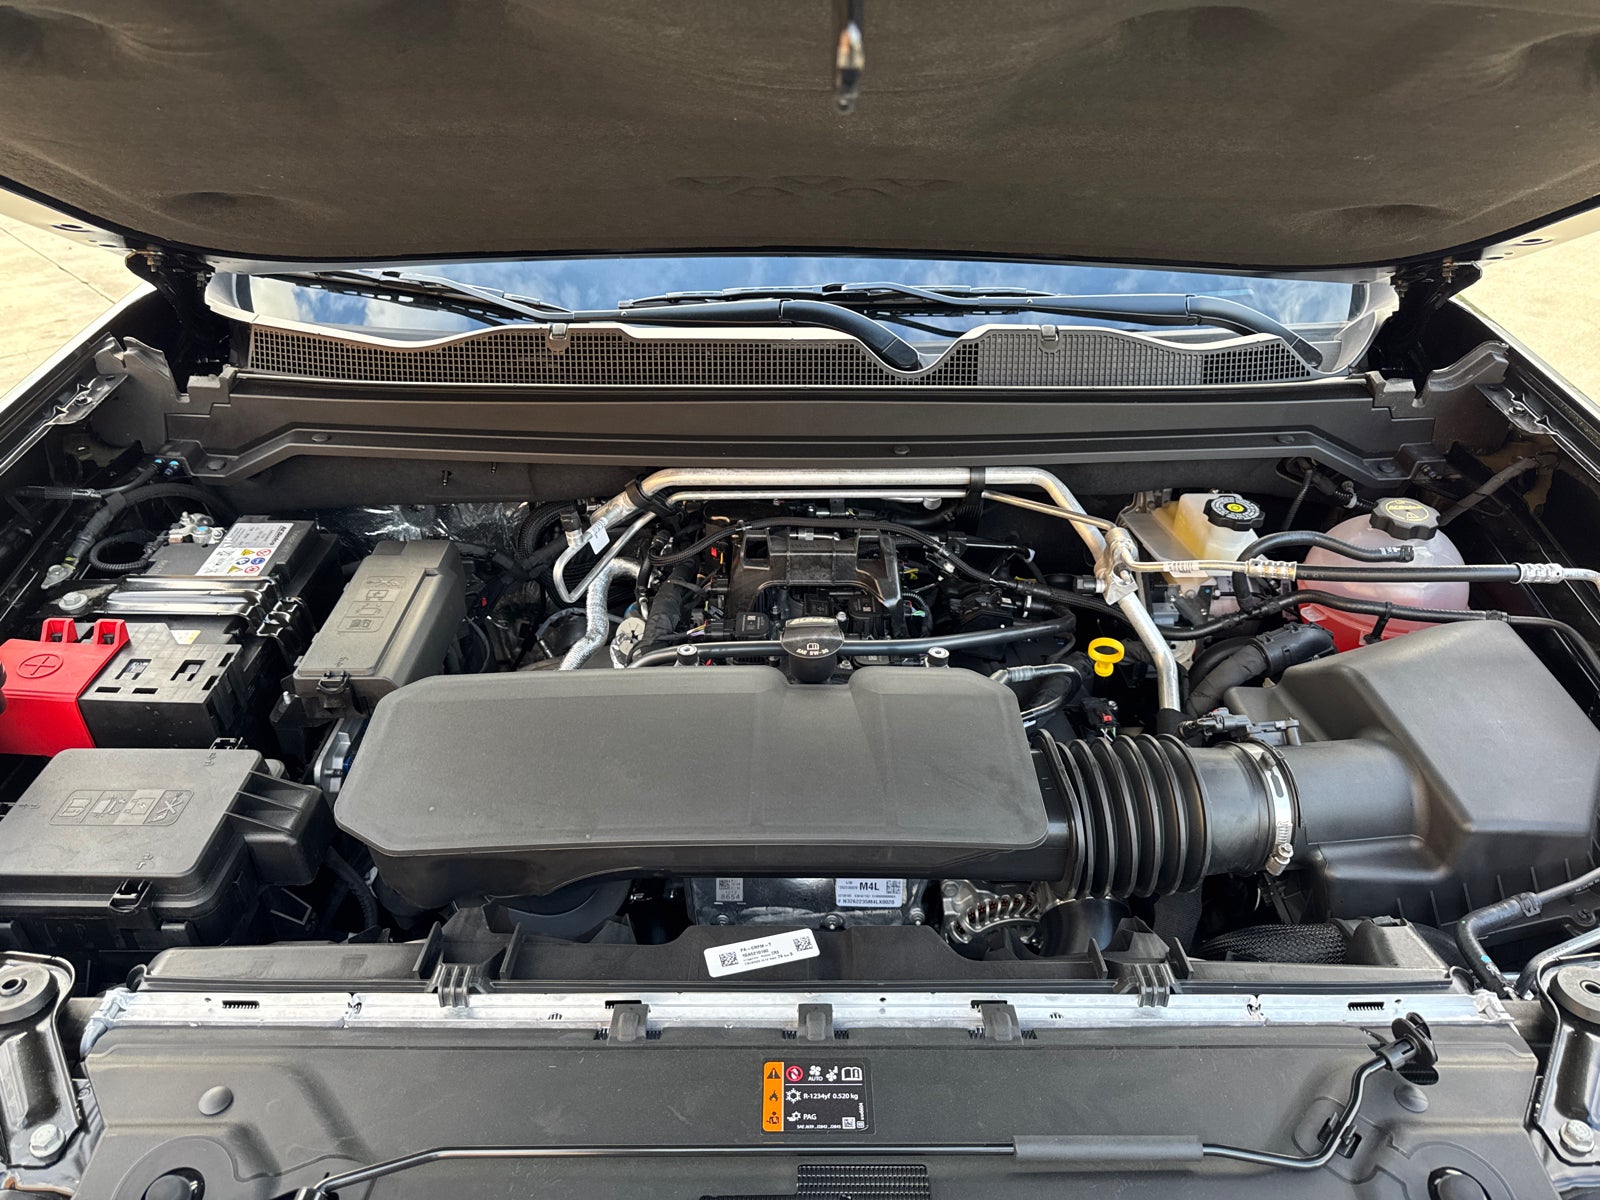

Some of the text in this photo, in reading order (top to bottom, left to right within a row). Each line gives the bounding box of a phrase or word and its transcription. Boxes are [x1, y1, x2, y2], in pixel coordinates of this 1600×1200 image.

[859, 882, 880, 891] M4L
[803, 1092, 831, 1100] R-1234yf
[850, 1092, 859, 1100] kg
